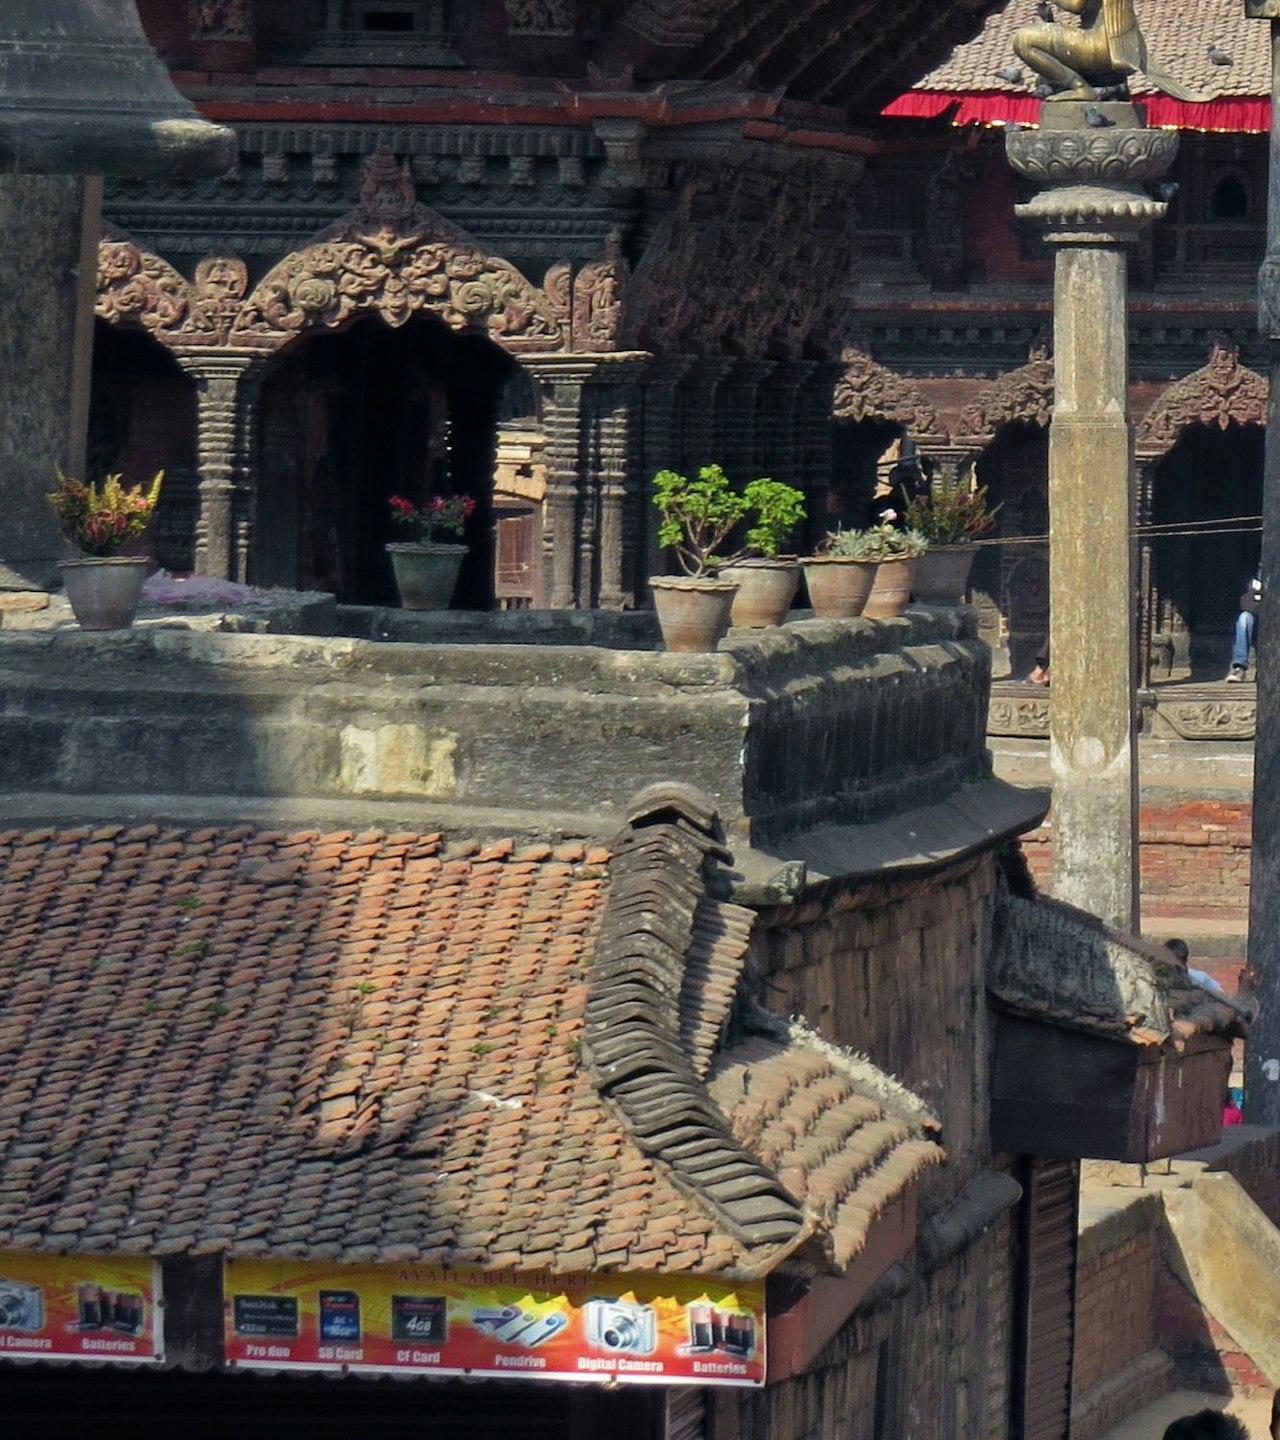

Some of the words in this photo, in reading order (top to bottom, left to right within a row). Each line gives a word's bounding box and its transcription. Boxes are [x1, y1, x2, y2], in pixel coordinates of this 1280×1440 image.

[400, 1269, 523, 1284] AVAILABLE
[534, 1273, 593, 1287] HERE
[406, 1315, 432, 1332] 4GB
[7, 1335, 52, 1349] Camera
[82, 1337, 136, 1352] Batteries
[246, 1344, 266, 1357] Pro
[318, 1347, 334, 1359] SD
[336, 1348, 364, 1361] Card
[413, 1351, 441, 1364] Card
[495, 1354, 547, 1369] Pendrive
[577, 1357, 616, 1371] Digital
[618, 1358, 664, 1373] Camera
[693, 1361, 748, 1375] Batteries
